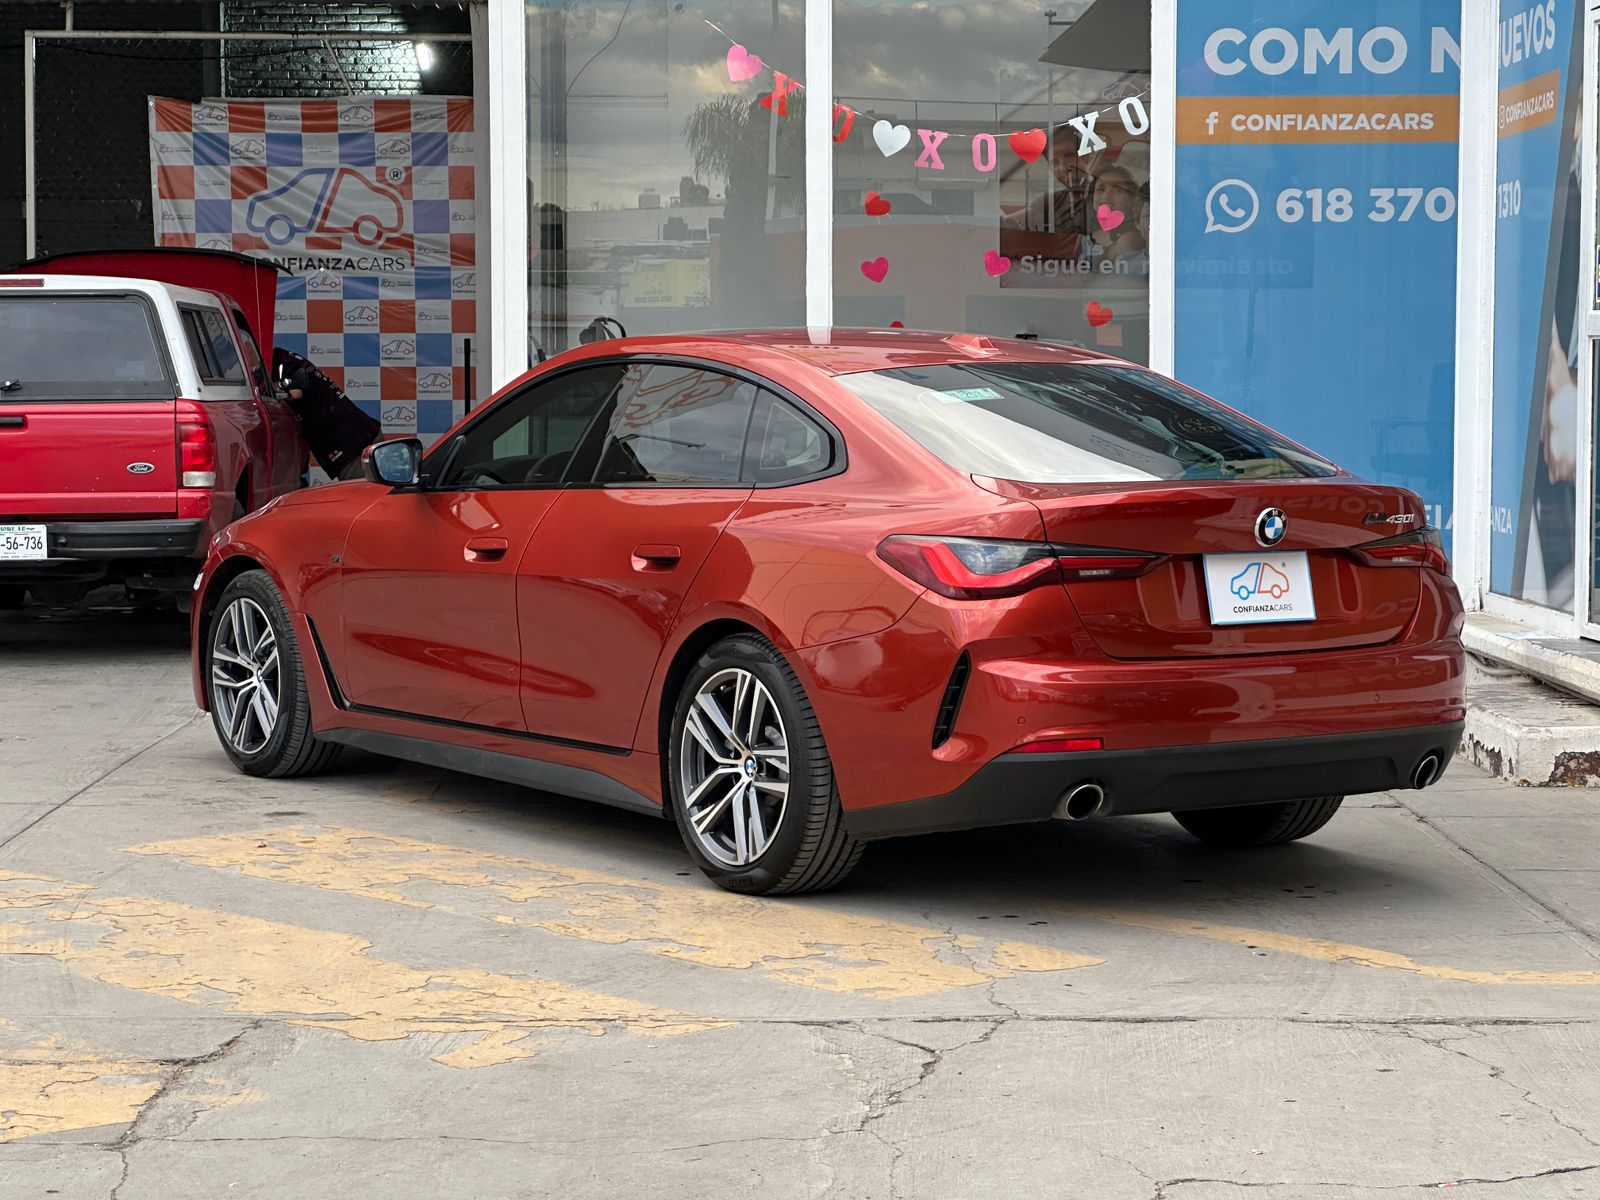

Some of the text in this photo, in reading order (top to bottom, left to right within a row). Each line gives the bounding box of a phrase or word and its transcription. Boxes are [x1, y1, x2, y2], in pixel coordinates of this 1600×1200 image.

[1203, 26, 1408, 76] COMO
[1230, 112, 1435, 133] CONFIANZACARS
[1505, 90, 1555, 124] CONFIANZACARS
[915, 128, 949, 171] X
[971, 133, 998, 173] O
[1068, 110, 1108, 158] X
[1118, 96, 1150, 137] O
[1276, 186, 1456, 223] 618 370
[1497, 179, 1521, 218] 1310
[264, 256, 405, 271] NFIANZACARS
[1020, 254, 1091, 278] Sigue
[1099, 258, 1129, 274] en
[1233, 603, 1293, 614] CONFIANZACARS
